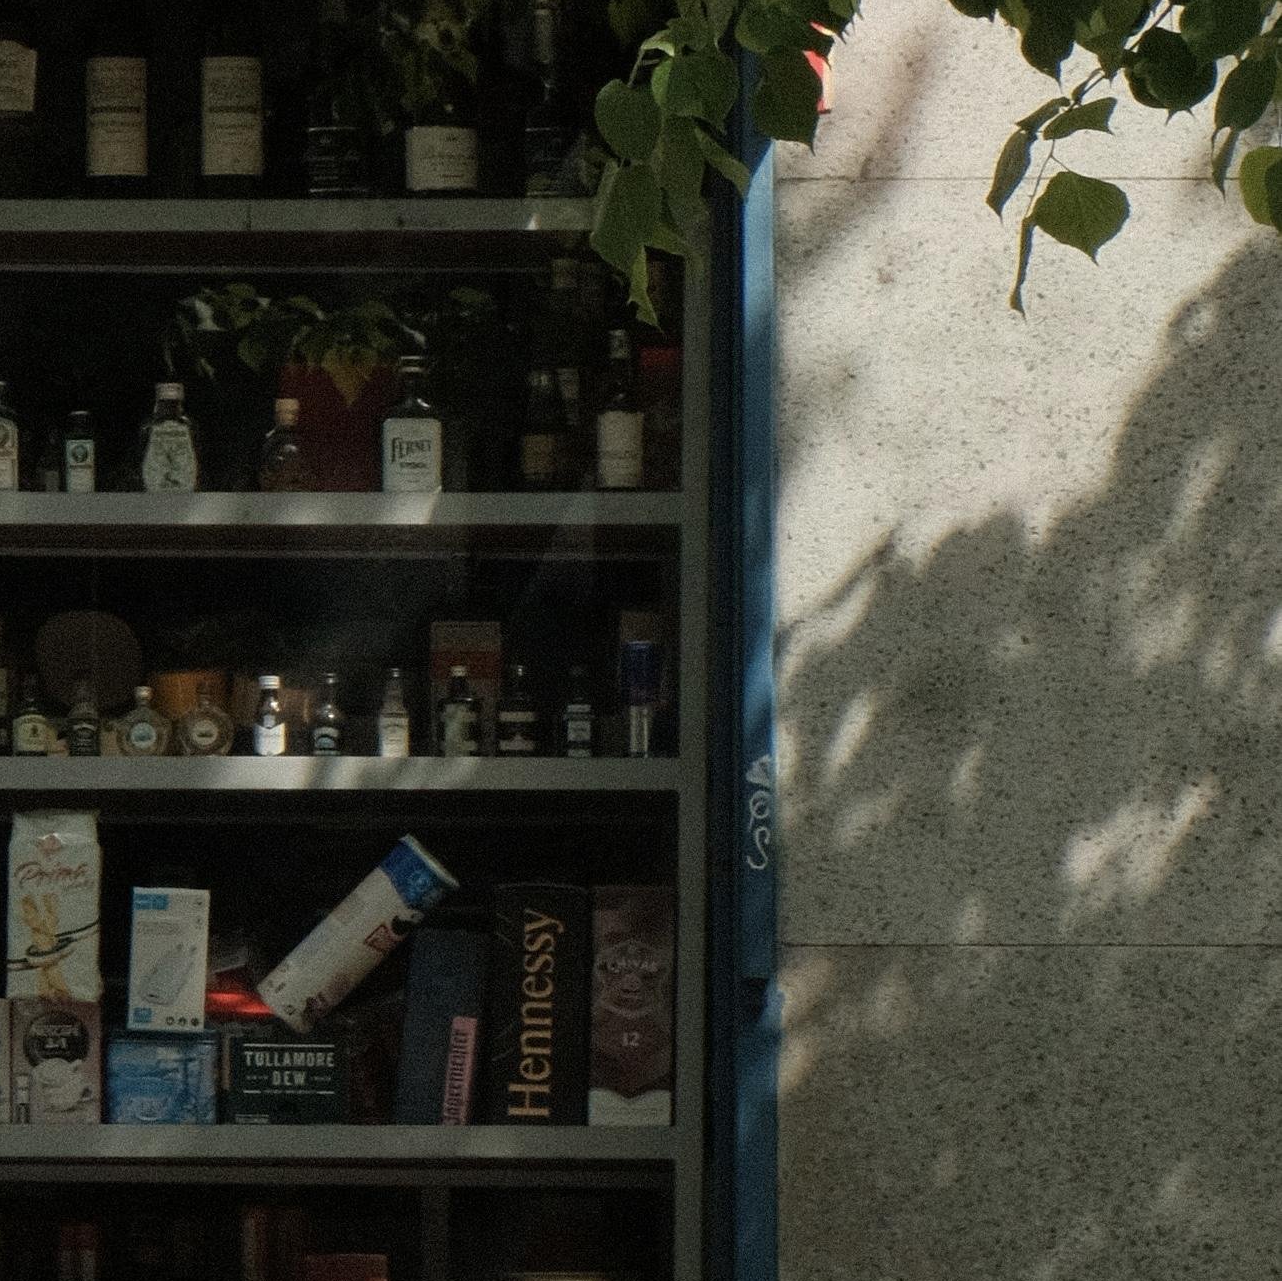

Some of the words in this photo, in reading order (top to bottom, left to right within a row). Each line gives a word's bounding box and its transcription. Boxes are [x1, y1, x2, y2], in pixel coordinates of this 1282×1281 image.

[508, 908, 566, 1118] Hennessy
[621, 1032, 640, 1049] 12
[243, 1051, 335, 1067] TULLAMORE
